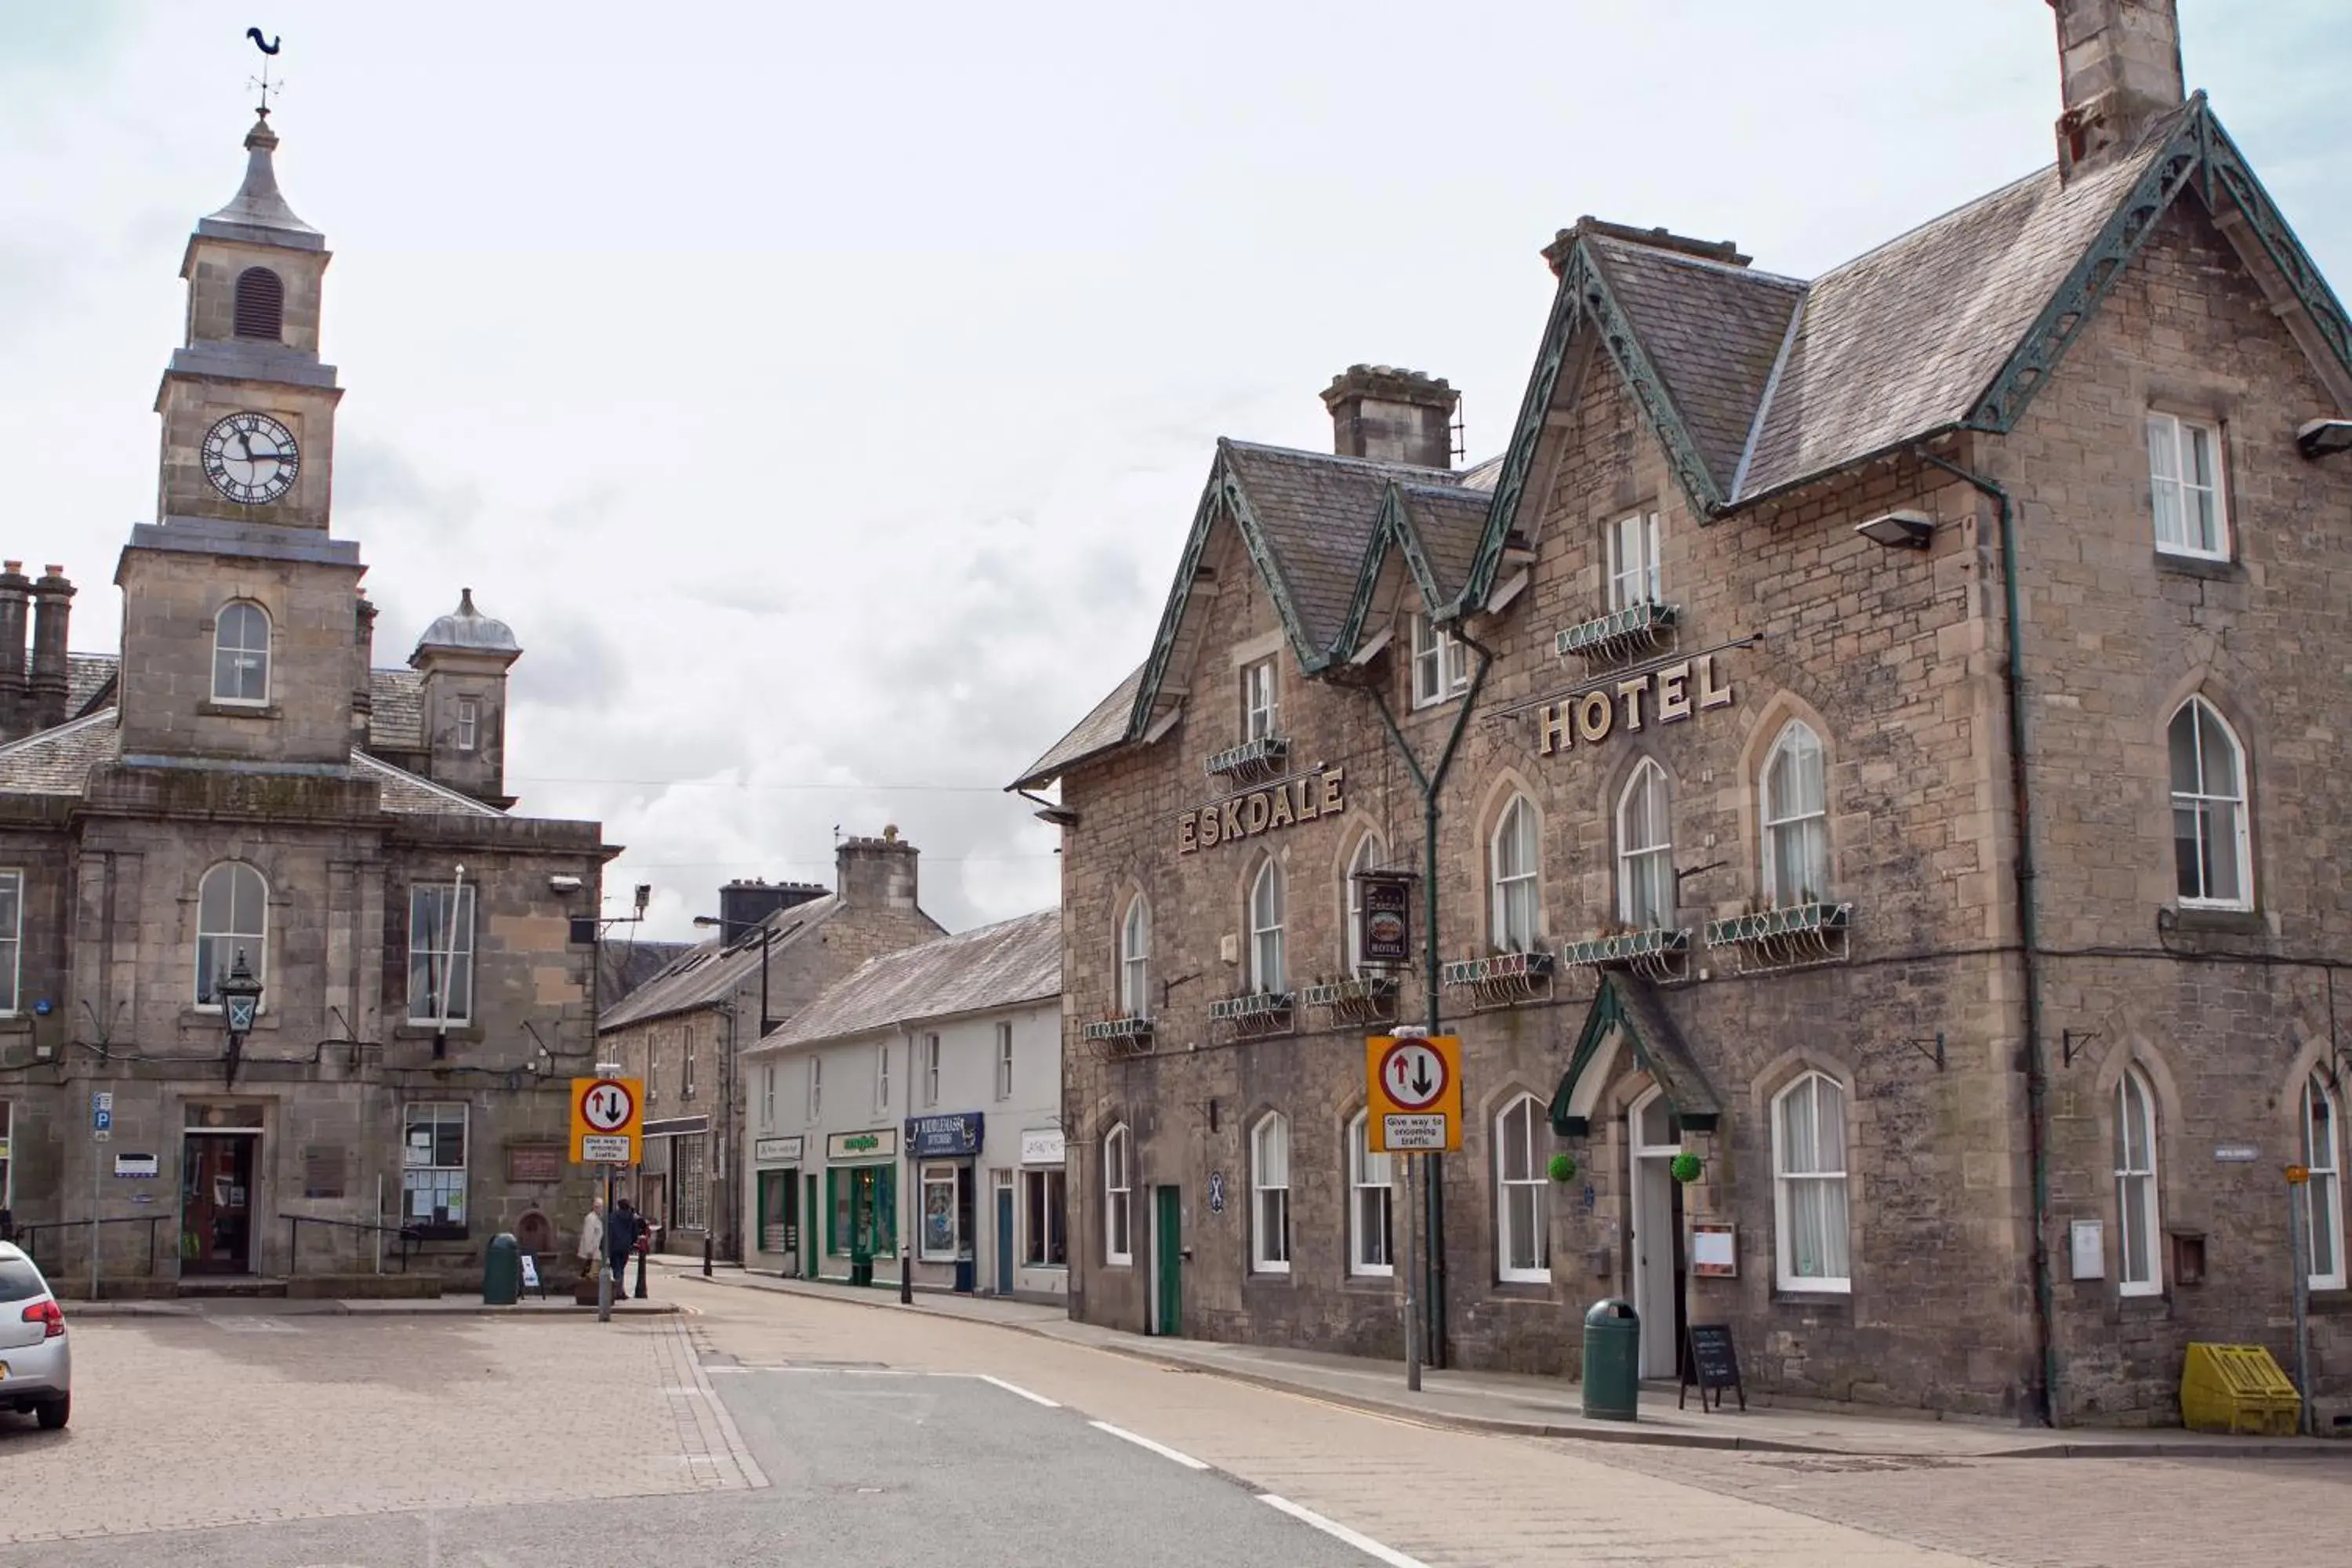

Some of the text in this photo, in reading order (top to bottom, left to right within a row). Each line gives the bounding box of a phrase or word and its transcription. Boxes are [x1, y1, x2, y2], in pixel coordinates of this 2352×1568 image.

[1540, 655, 1730, 754] HOTEL
[1178, 766, 1344, 854] ESKDALE
[98, 1113, 108, 1127] P
[1387, 1117, 1407, 1127] Give
[1411, 1118, 1429, 1127] way
[1395, 1127, 1436, 1136] oncoming
[1401, 1135, 1429, 1145] traffic
